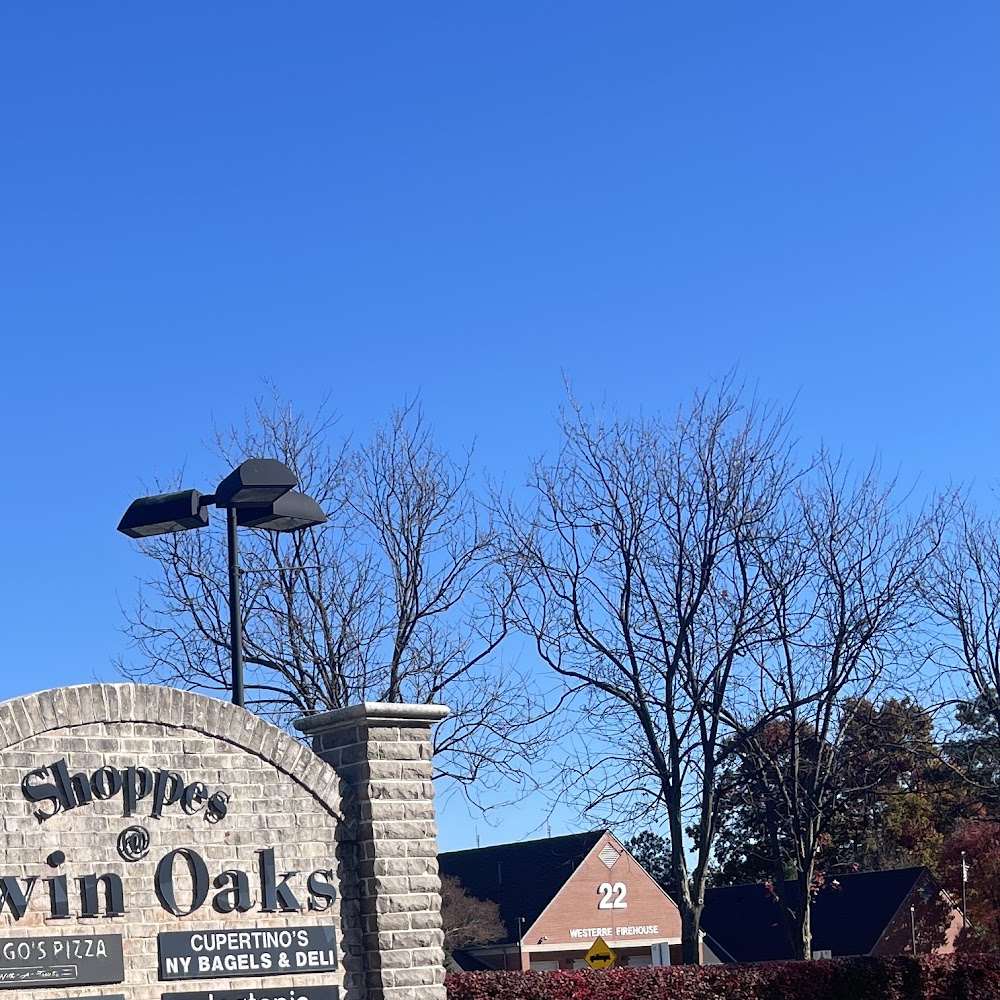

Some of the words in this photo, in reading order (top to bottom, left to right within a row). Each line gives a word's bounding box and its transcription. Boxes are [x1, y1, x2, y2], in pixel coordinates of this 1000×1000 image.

[21, 758, 231, 824] Shoppes
[116, 825, 150, 862] @
[154, 847, 337, 917] Oaks
[598, 882, 628, 909] 22
[190, 930, 309, 951] CUPERTINO'S
[570, 927, 613, 938] WESTERRE
[616, 925, 659, 936] FIREHOUSE
[53, 939, 107, 959] PIZZA
[166, 956, 191, 974] NY
[198, 953, 272, 972] BAGELS
[278, 952, 291, 968] &
[296, 950, 334, 967] DELI
